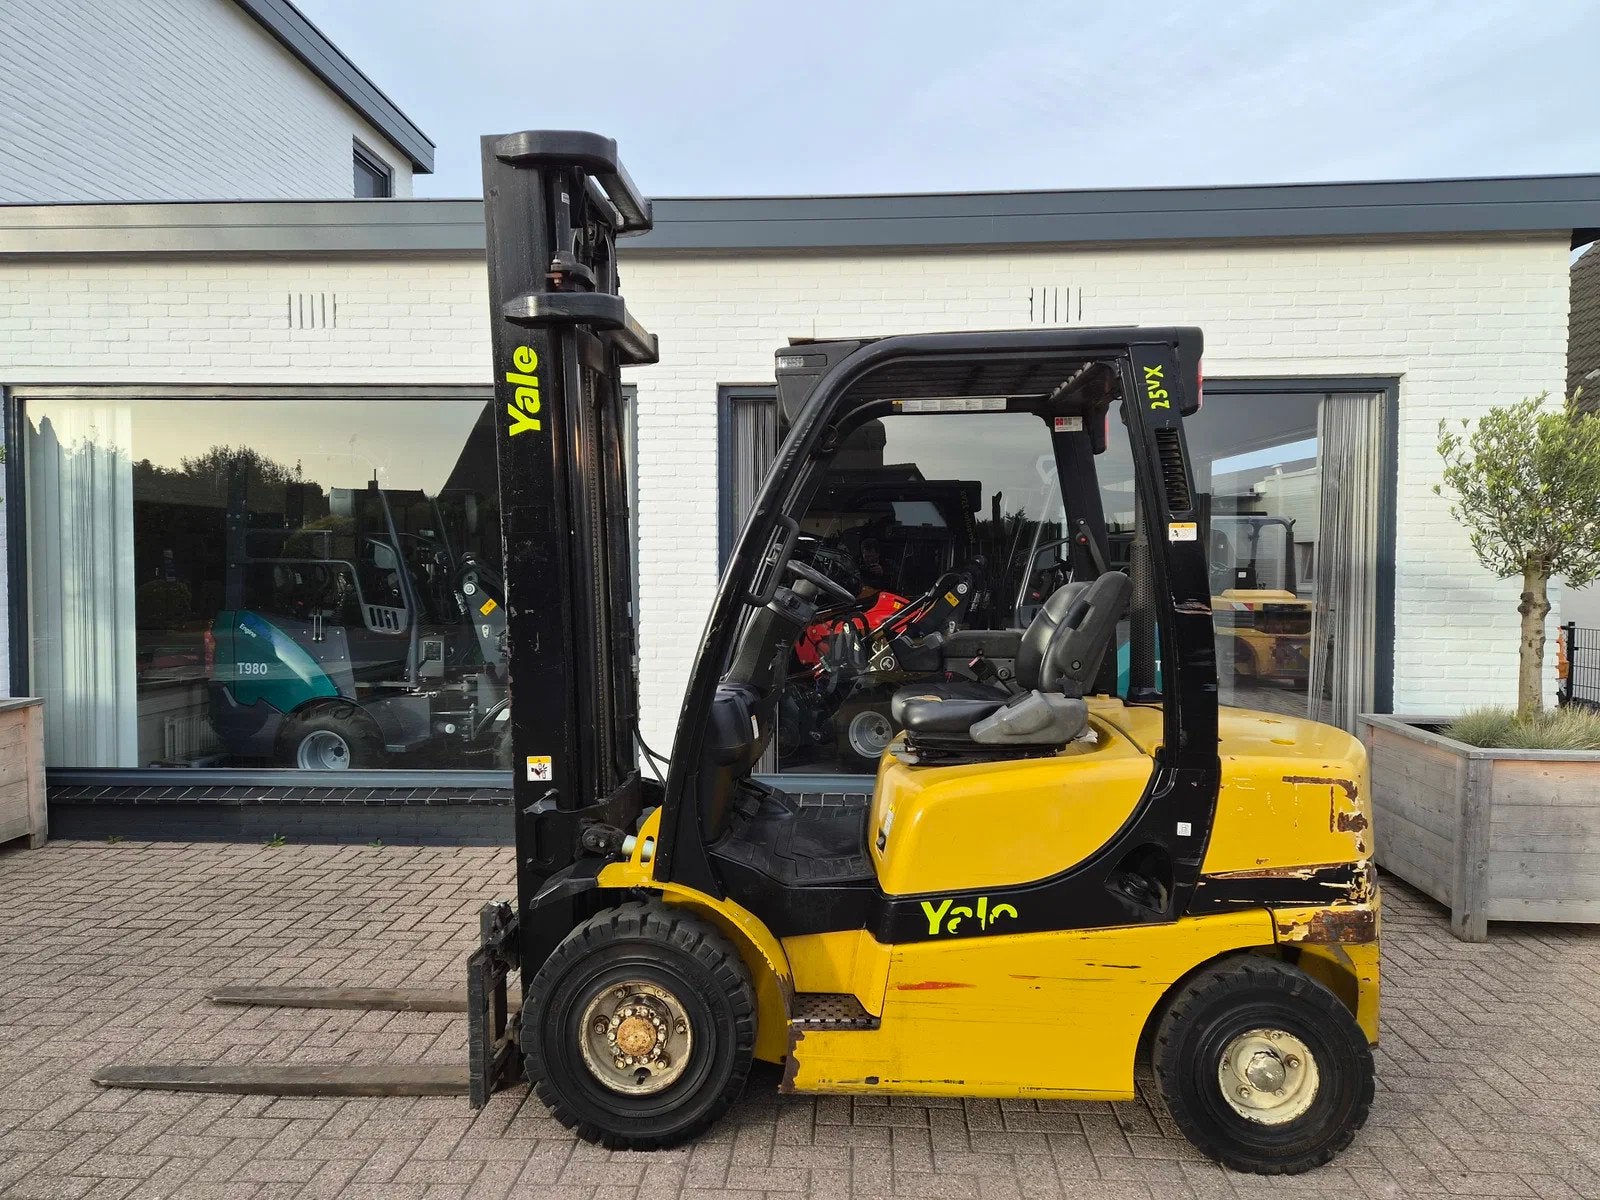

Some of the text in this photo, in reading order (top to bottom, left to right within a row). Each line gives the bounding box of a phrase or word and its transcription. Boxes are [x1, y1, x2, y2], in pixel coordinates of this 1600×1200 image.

[506, 346, 540, 436] Yale
[1143, 364, 1170, 409] 25VX
[237, 662, 268, 675] T980
